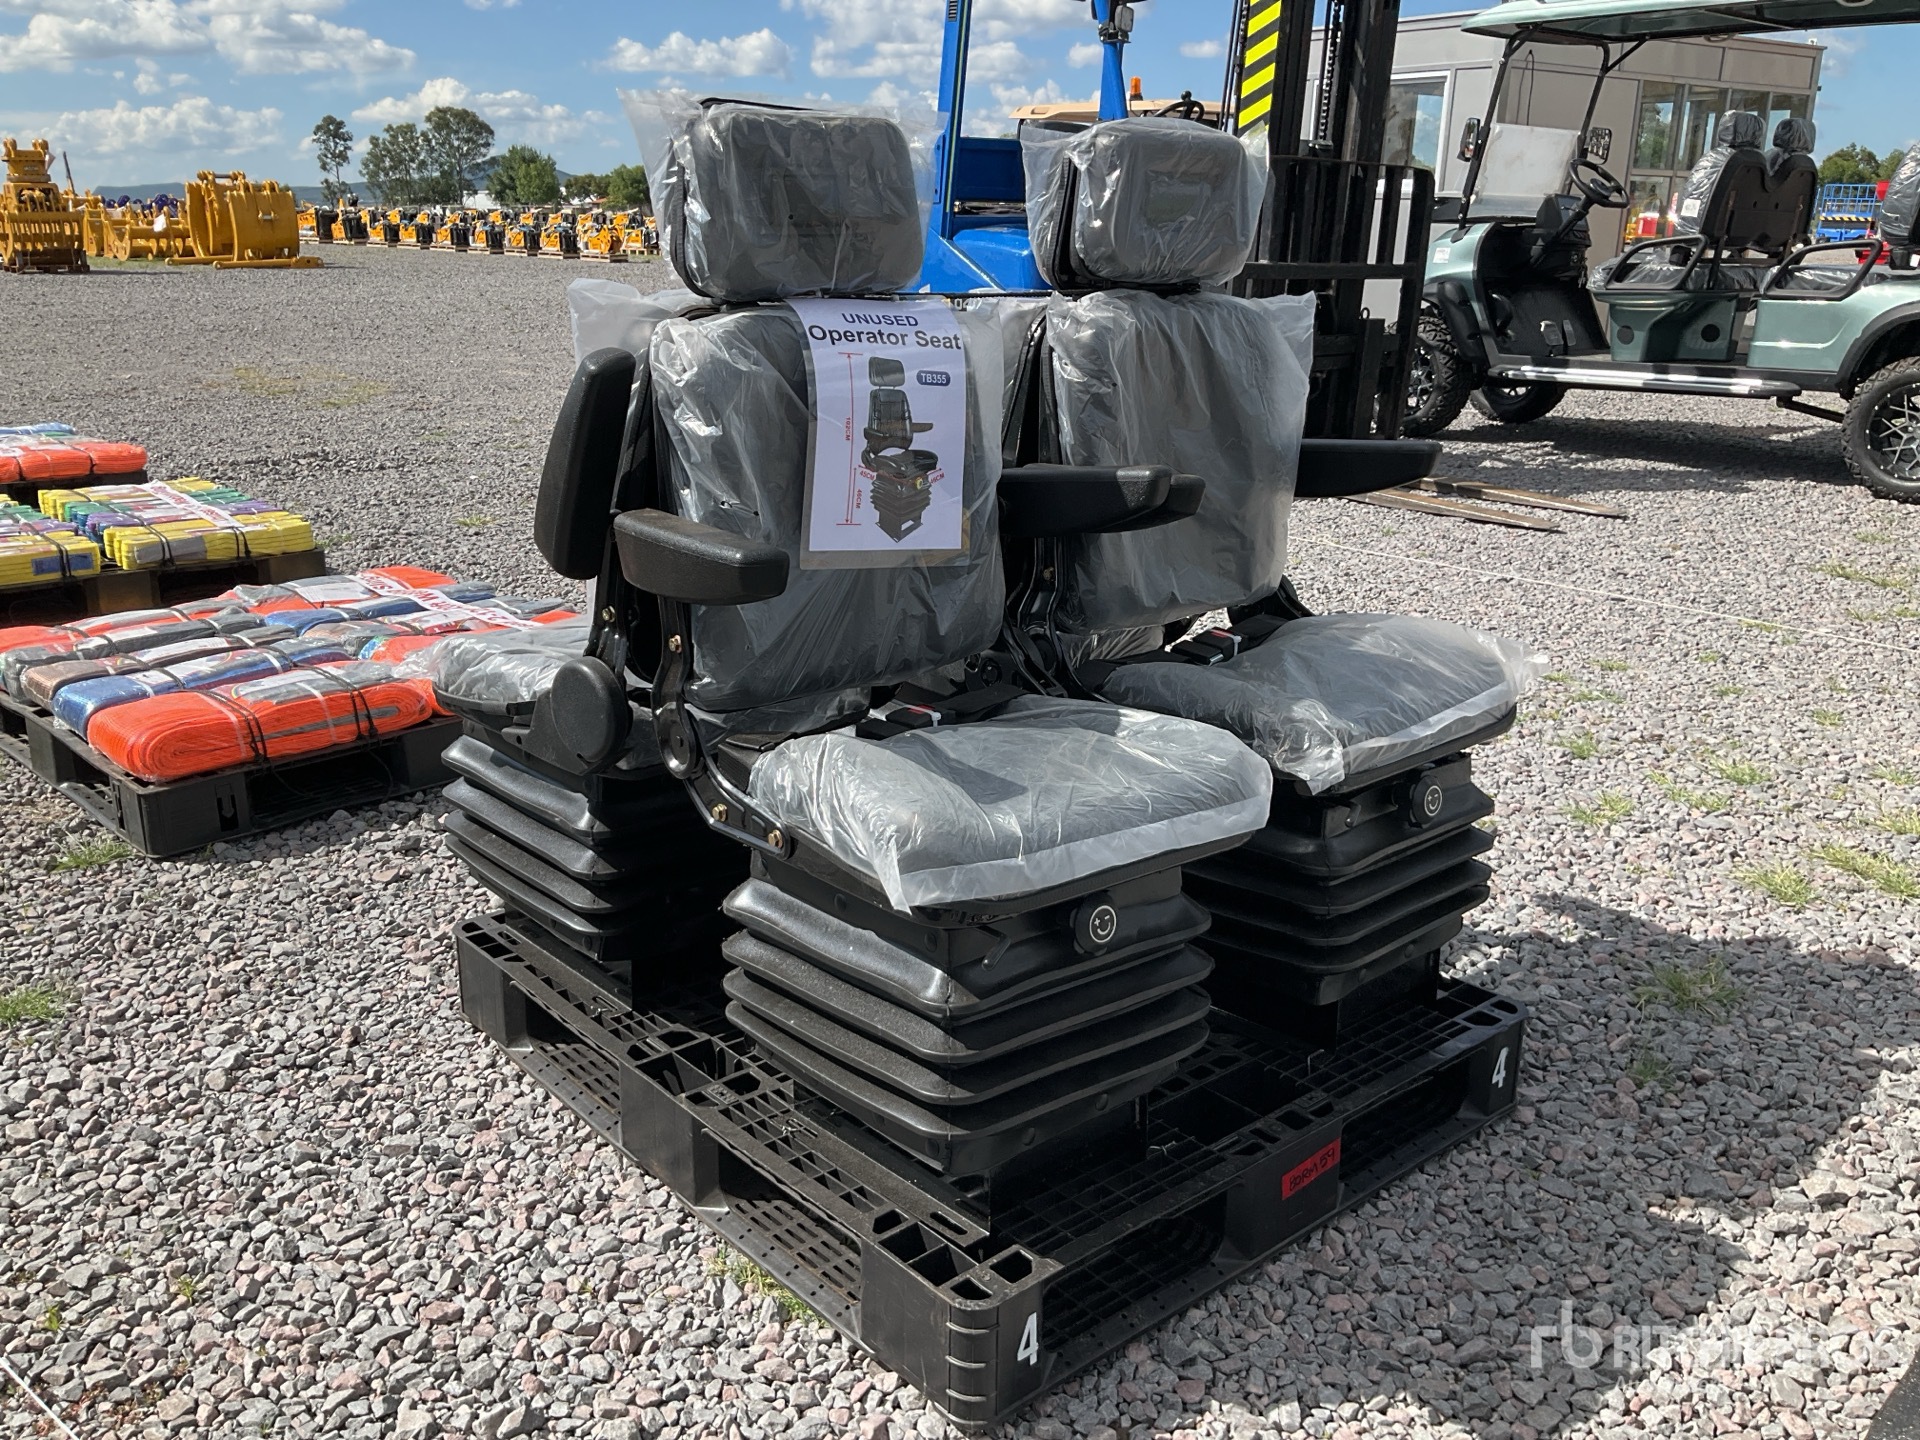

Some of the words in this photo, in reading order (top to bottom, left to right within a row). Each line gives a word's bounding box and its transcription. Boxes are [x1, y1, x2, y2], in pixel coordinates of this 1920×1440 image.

[842, 313, 918, 327] UNUSED
[808, 325, 908, 345] Operator
[915, 330, 961, 350] Seat
[921, 373, 947, 384] TB355
[1491, 1046, 1509, 1089] 4
[1017, 1311, 1039, 1366] 4
